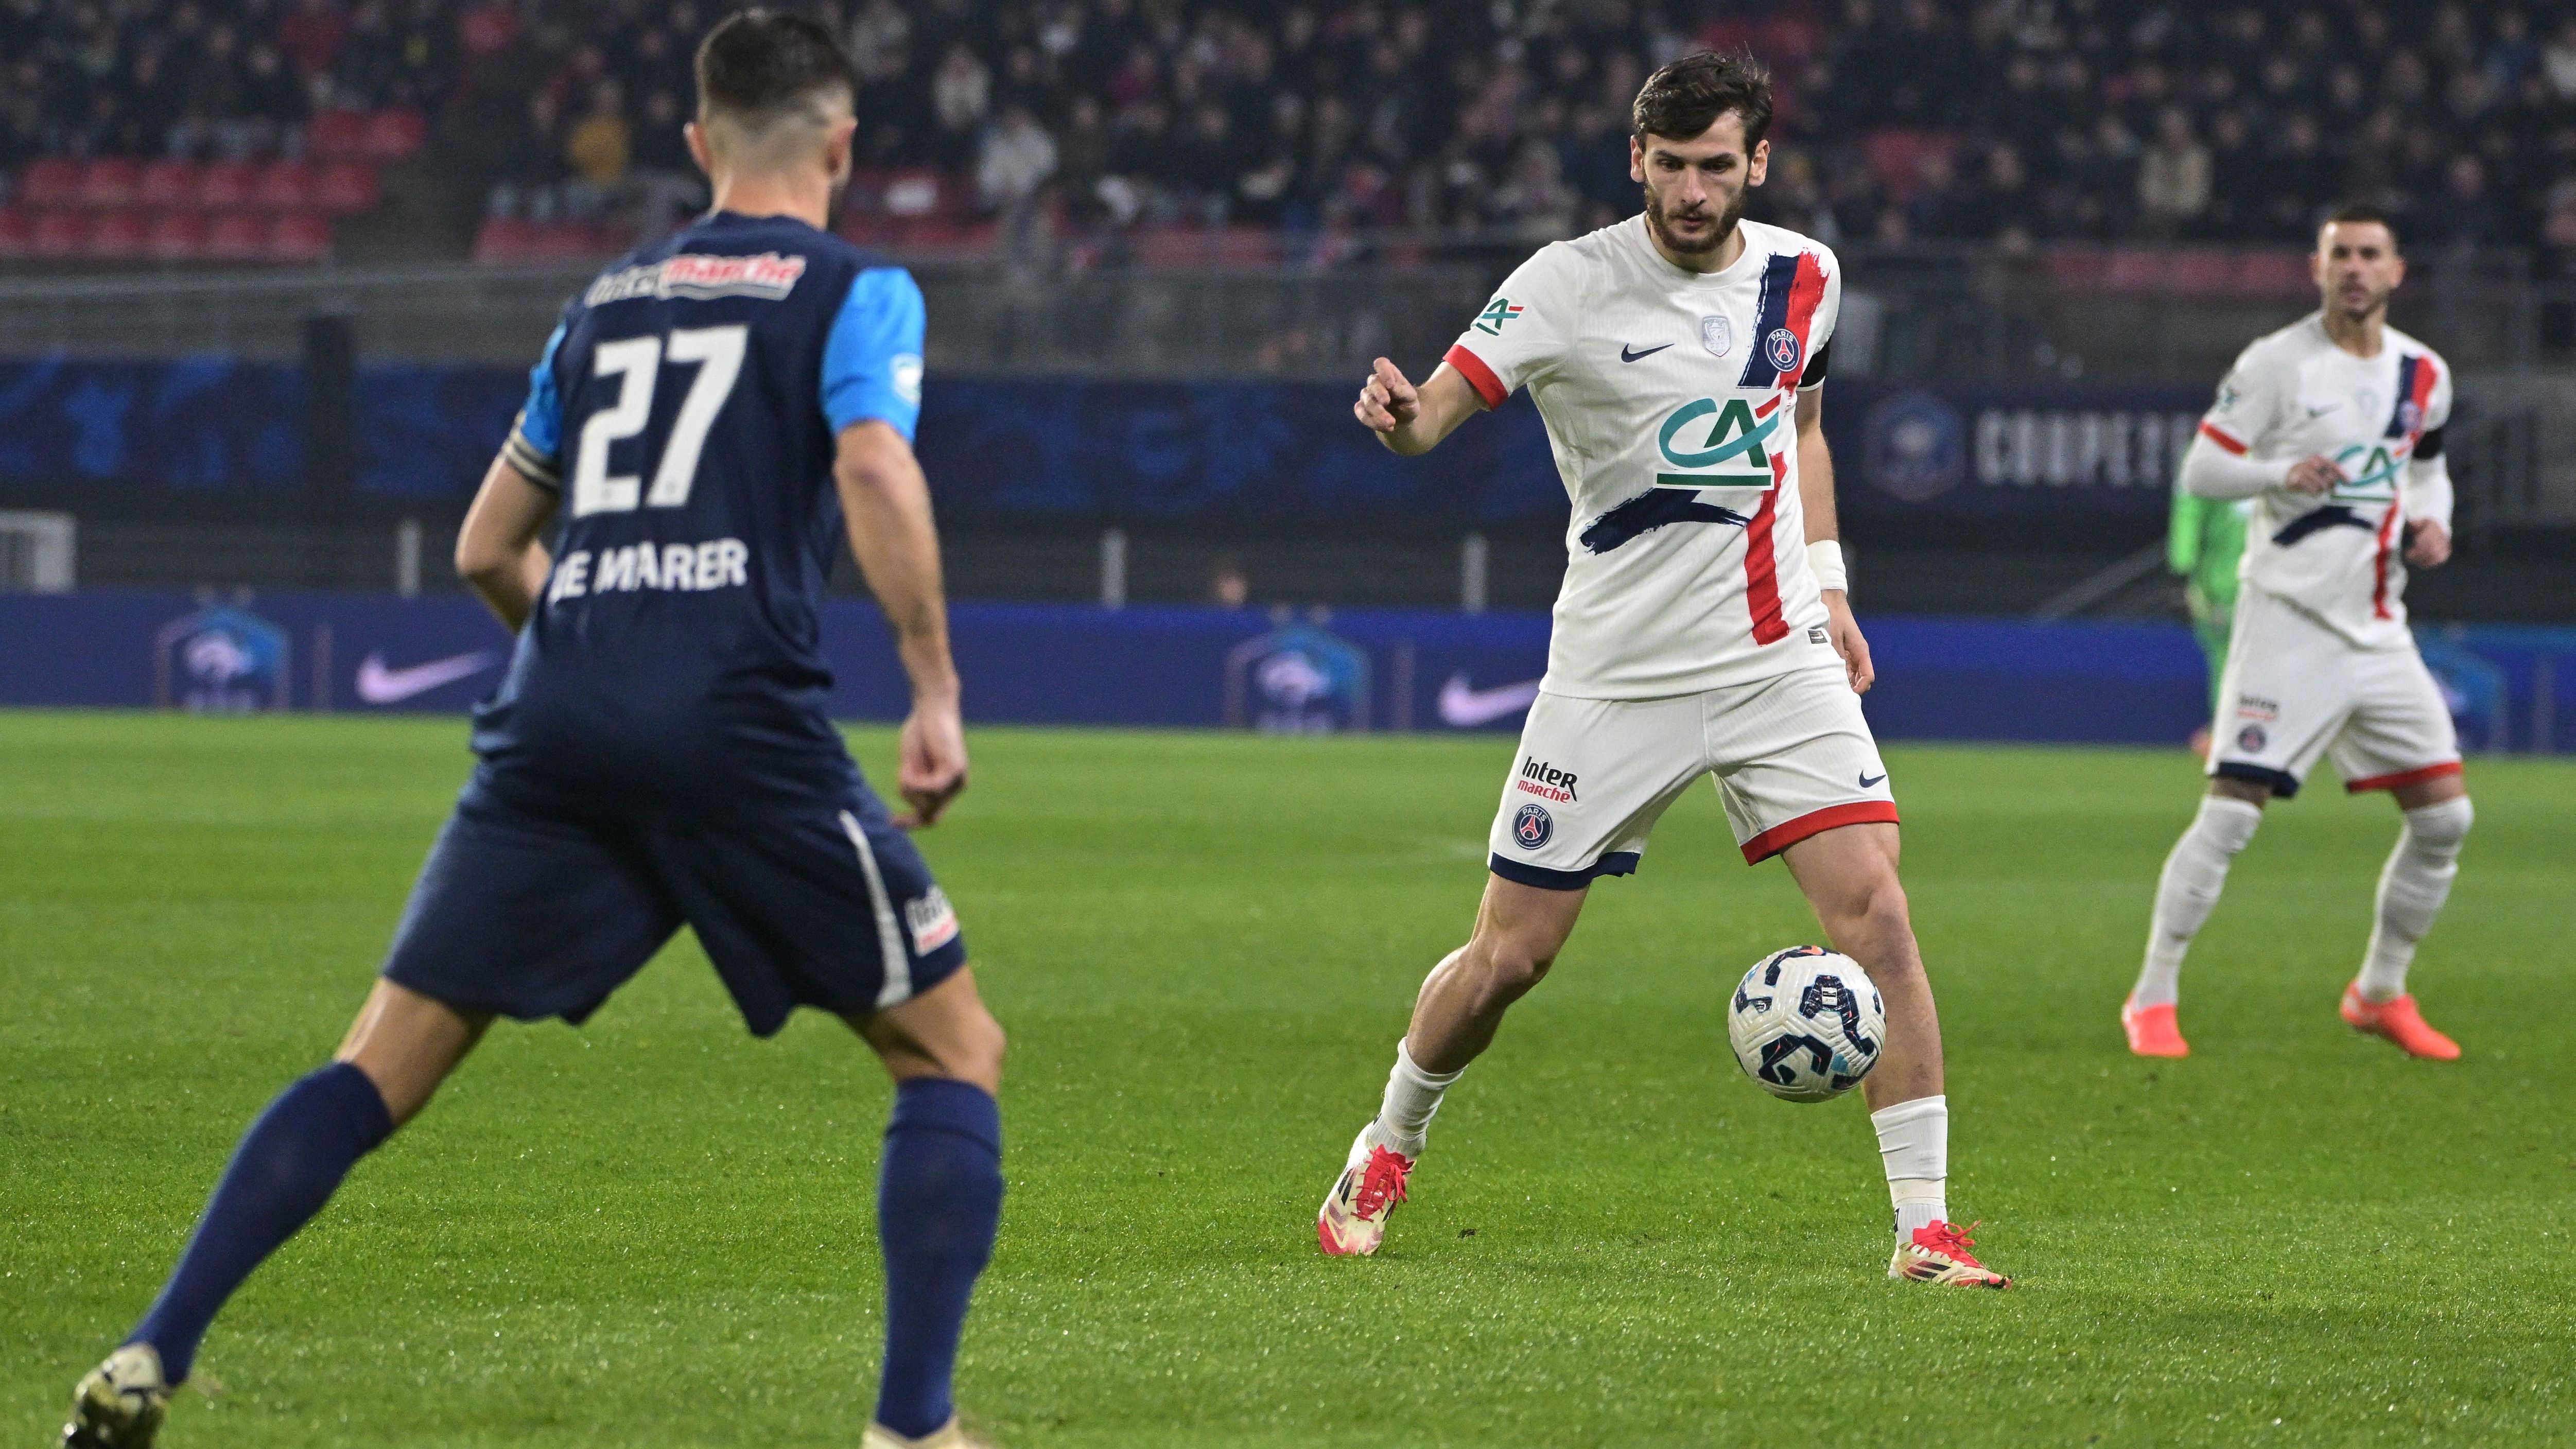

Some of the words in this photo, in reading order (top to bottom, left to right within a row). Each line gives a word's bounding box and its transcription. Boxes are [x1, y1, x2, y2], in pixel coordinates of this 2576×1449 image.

[1771, 331, 1794, 341] PARIS
[573, 324, 749, 518] 27
[1659, 397, 1780, 468] CA
[593, 538, 749, 593] MARER
[1522, 807, 1547, 822] PARIS
